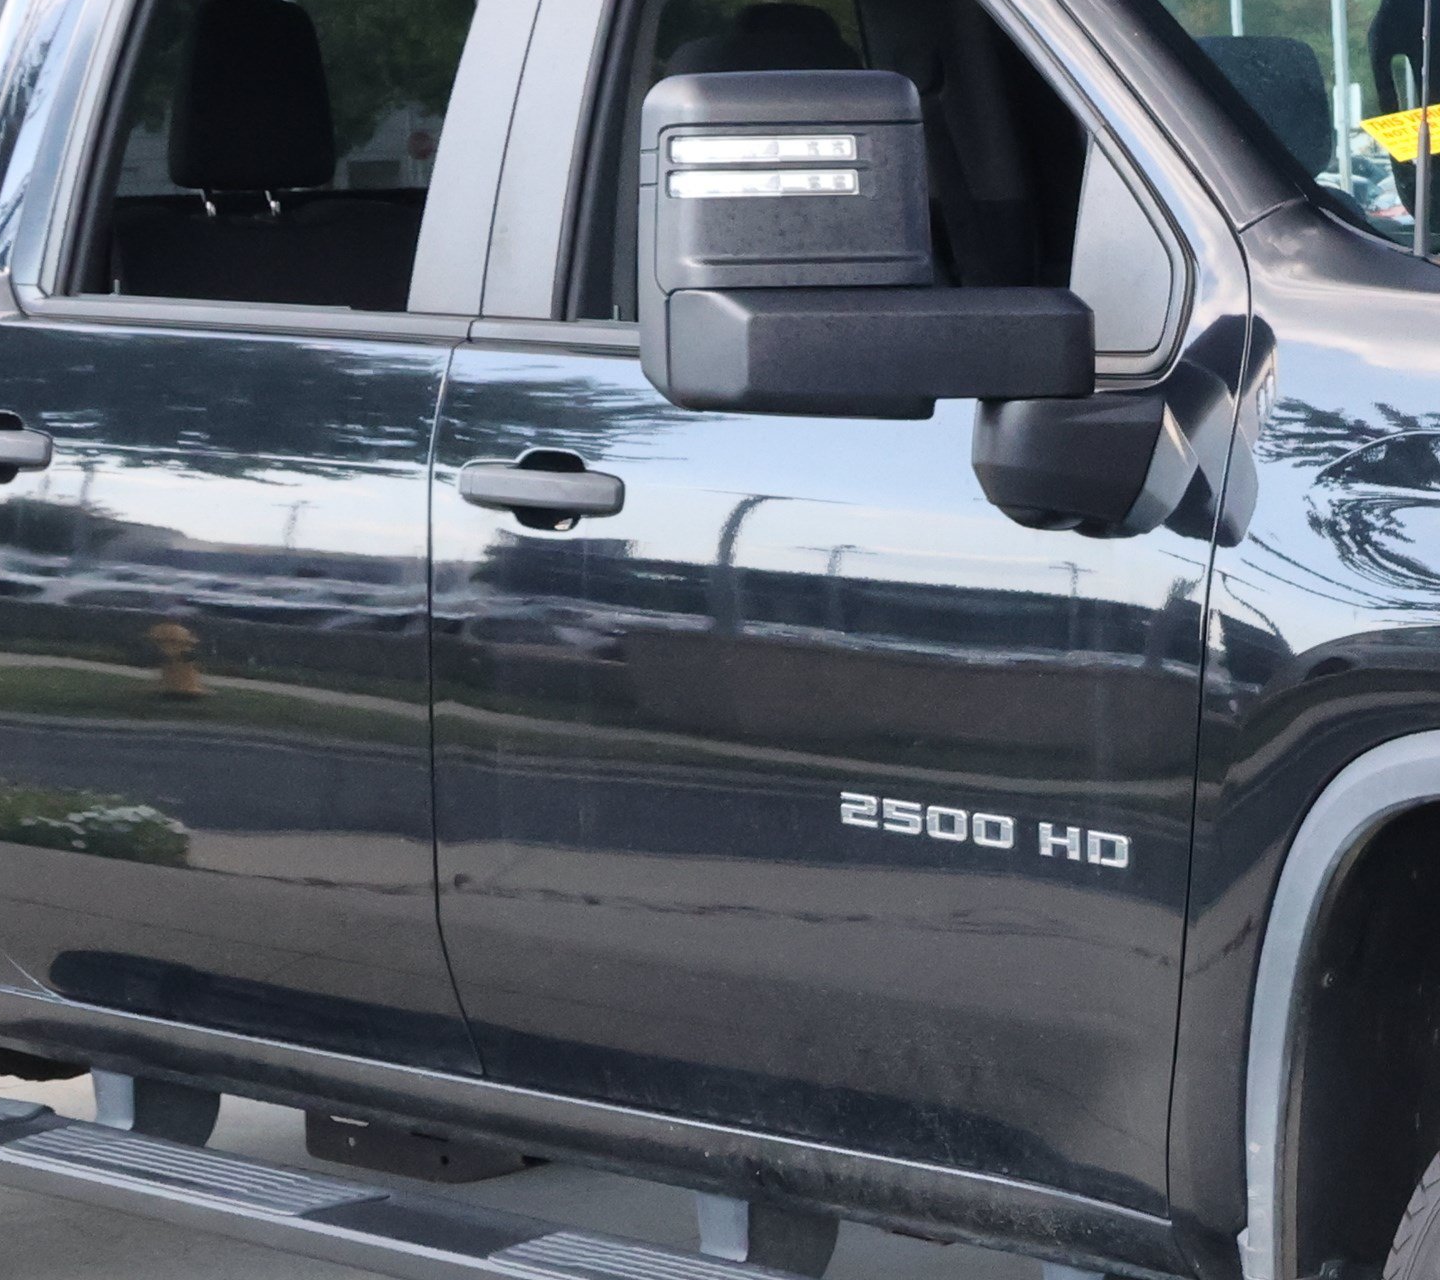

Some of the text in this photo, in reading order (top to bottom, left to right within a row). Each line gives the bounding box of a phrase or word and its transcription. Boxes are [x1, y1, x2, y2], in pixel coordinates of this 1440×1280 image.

[1368, 117, 1404, 132] THIS
[841, 791, 1131, 868] 2500 HD
